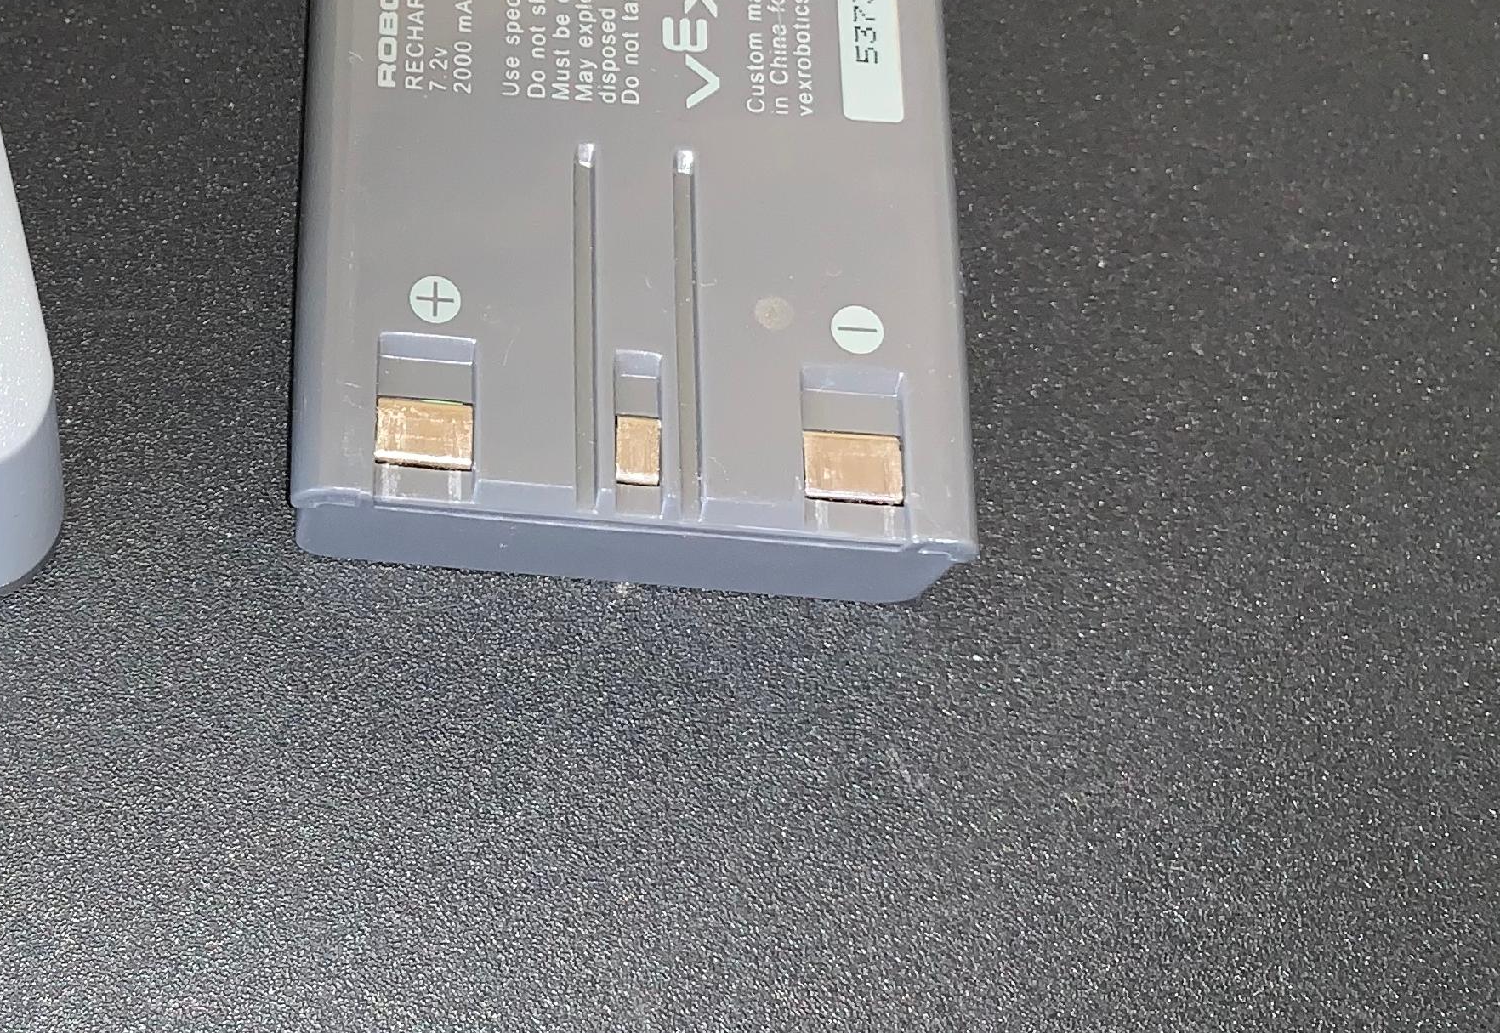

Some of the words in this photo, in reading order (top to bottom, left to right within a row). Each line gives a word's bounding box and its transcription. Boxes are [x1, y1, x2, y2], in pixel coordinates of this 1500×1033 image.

[529, 26, 546, 58] not
[552, 14, 570, 38] be
[429, 47, 448, 91] 7.2v
[453, 41, 472, 94] 2000
[597, 8, 620, 104] disposed
[622, 32, 639, 65] not
[770, 24, 788, 85] China
[502, 56, 520, 96] Use
[527, 70, 546, 98] Do
[552, 49, 570, 100] Must
[574, 58, 598, 101] May
[621, 76, 640, 104] Do
[746, 32, 765, 112] Custom
[772, 97, 788, 116] in
